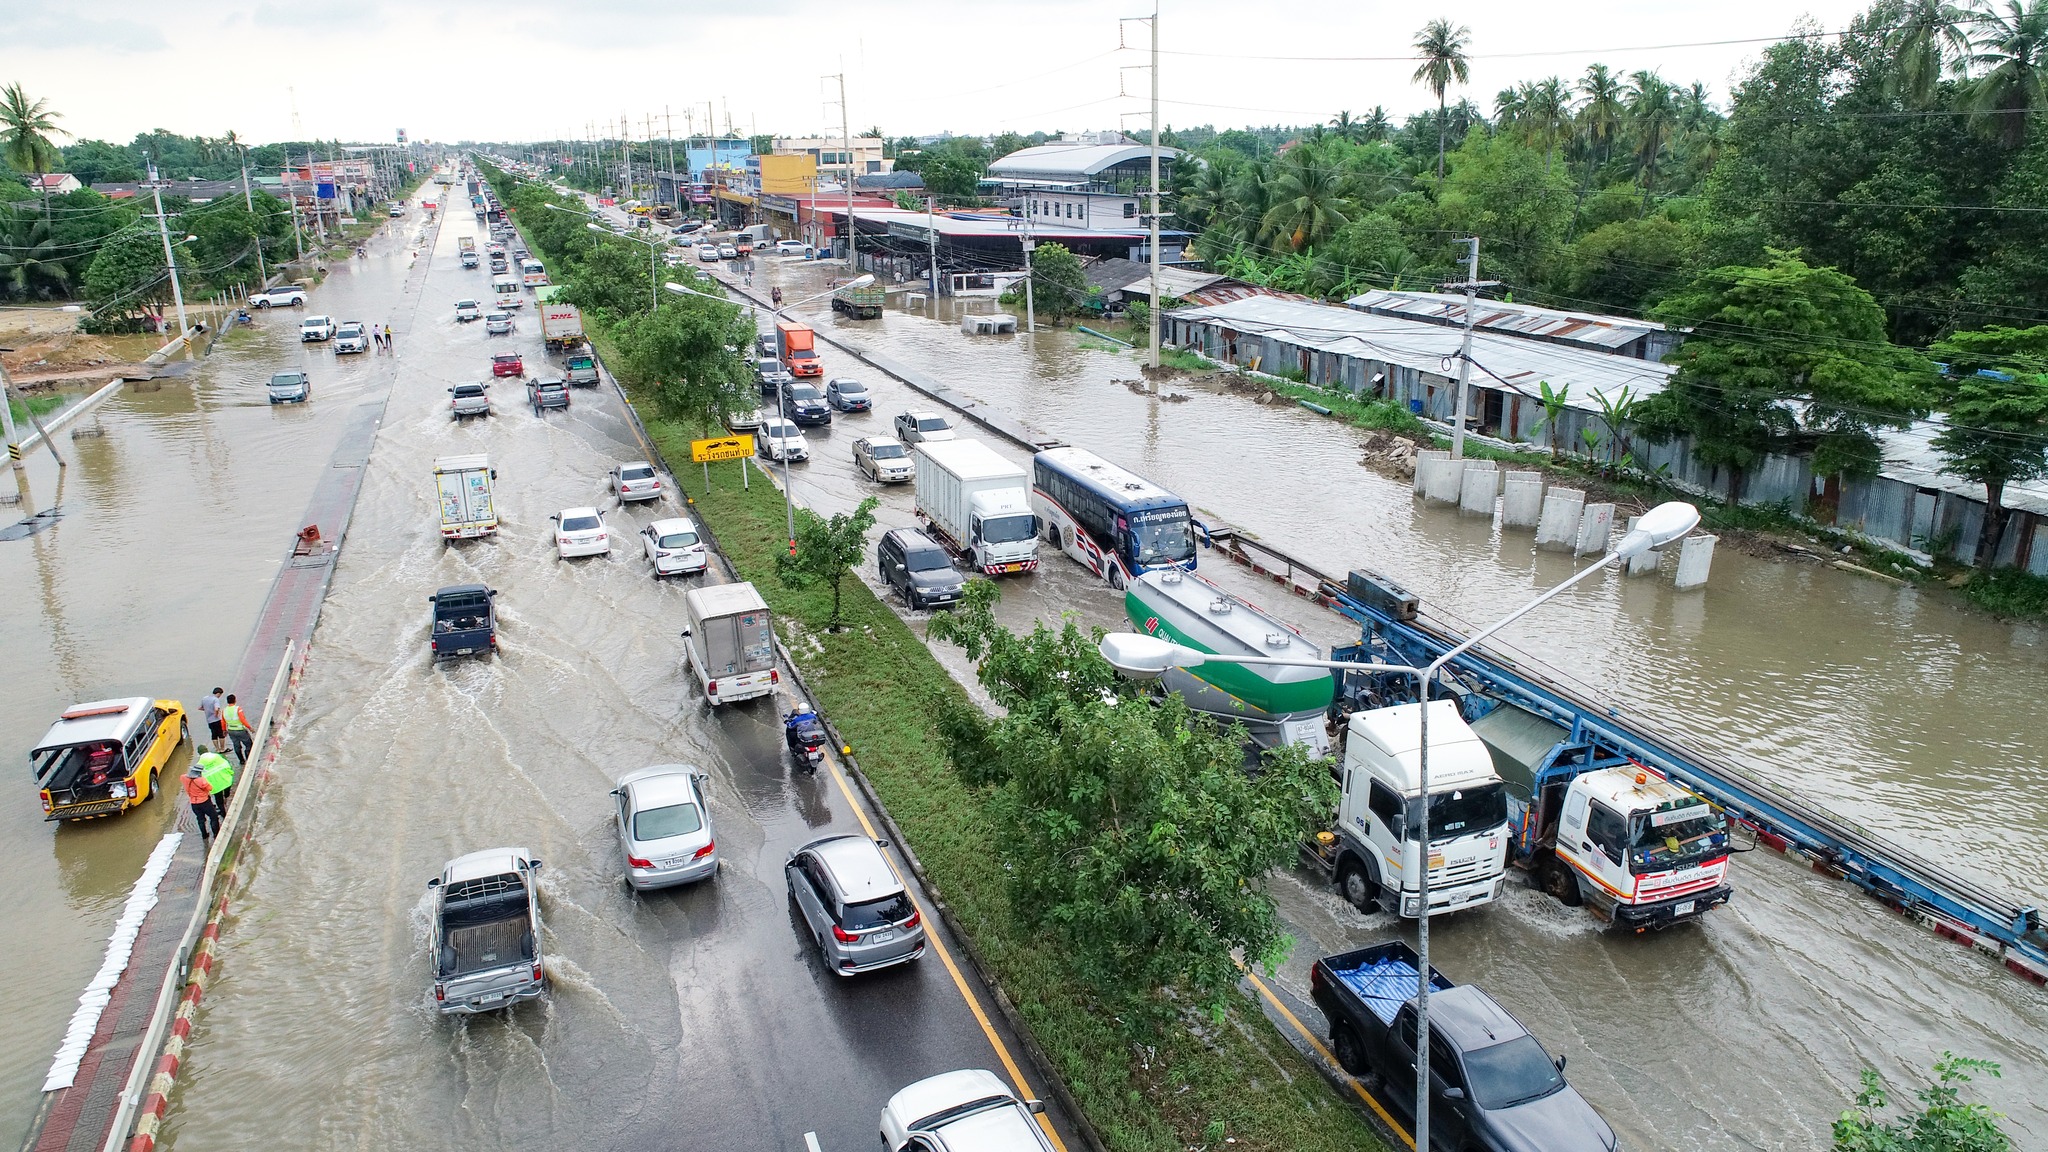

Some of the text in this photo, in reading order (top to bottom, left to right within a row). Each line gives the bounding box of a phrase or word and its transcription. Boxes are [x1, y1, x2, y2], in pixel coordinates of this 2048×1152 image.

[698, 447, 750, 461] ระวังรถชนท้าย
[1133, 509, 1187, 523] ก.เหรียญทองน้อย
[1456, 768, 1474, 776] MAX
[1355, 816, 1365, 827] 05
[1450, 855, 1476, 866] ISUZU
[1673, 861, 1700, 872] ISUZU
